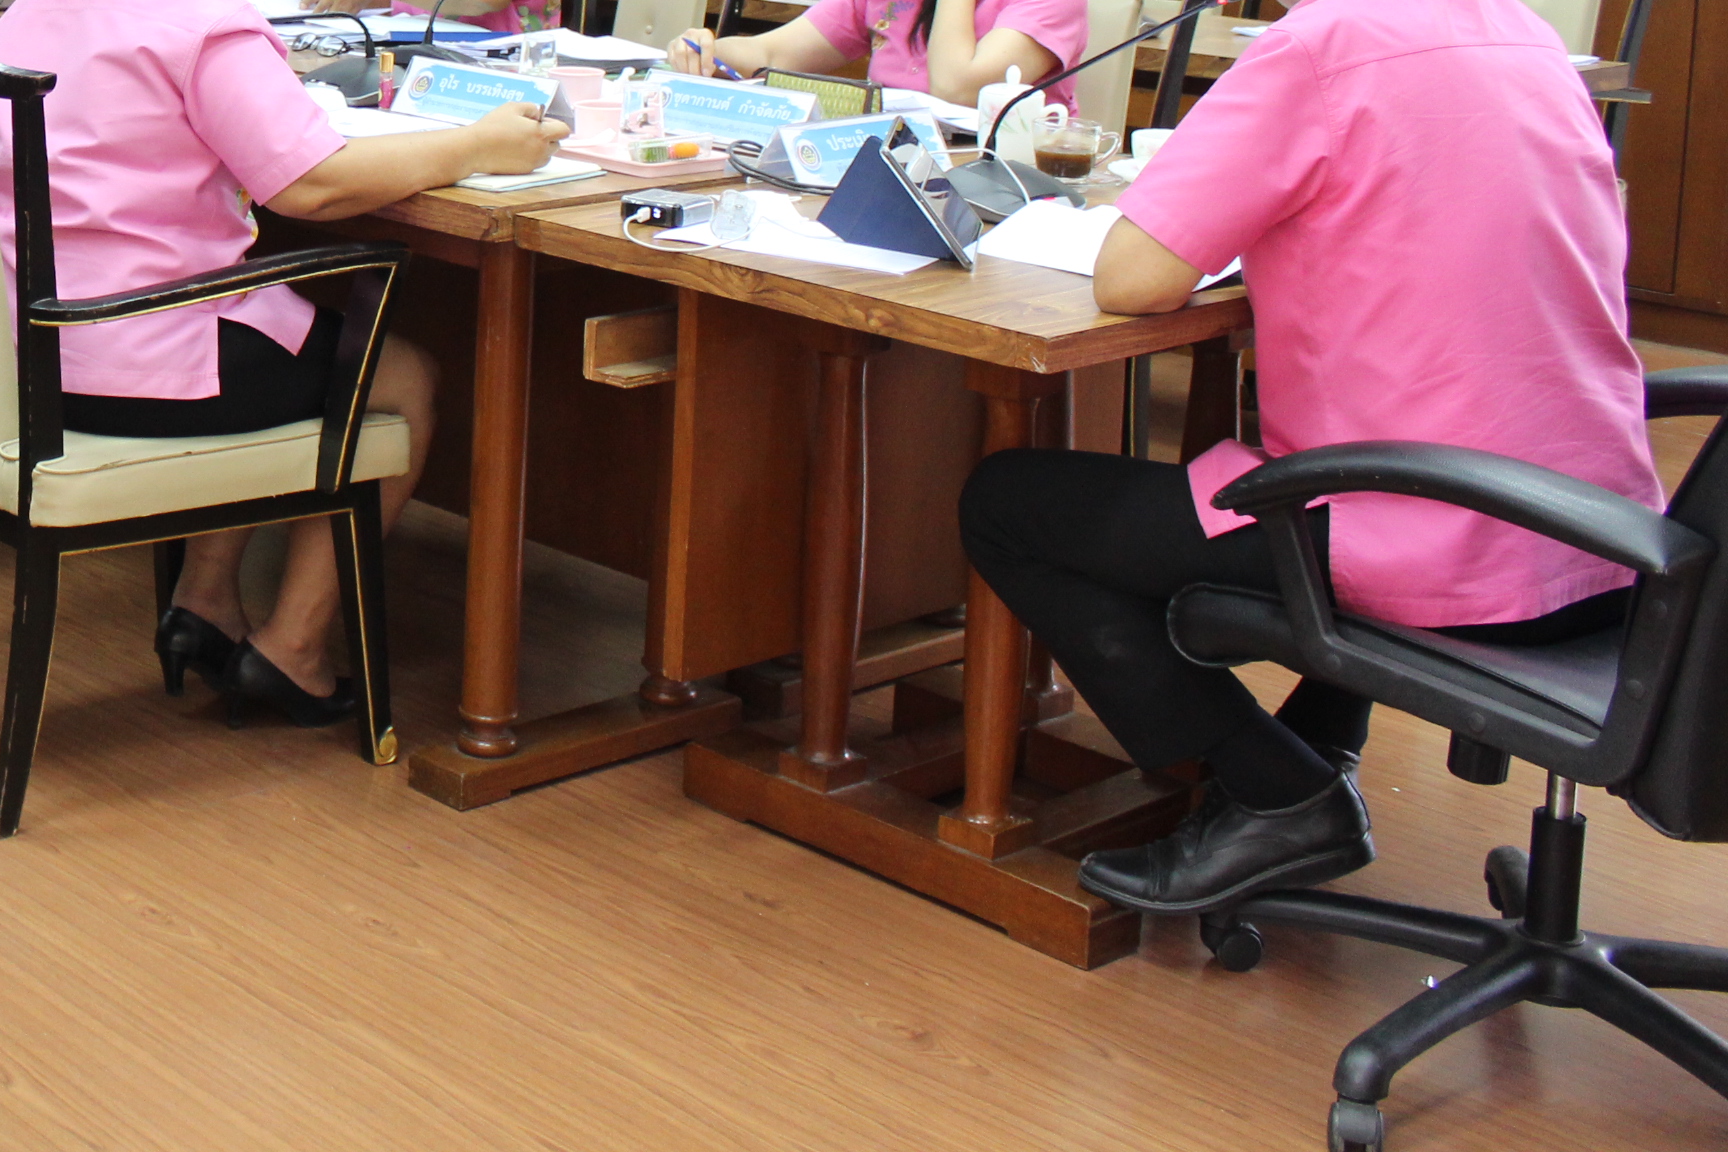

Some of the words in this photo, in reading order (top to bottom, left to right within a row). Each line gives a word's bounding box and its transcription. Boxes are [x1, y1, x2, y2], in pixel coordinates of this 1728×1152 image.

[438, 73, 460, 92] อุไร
[466, 82, 525, 101] บรรเทิงสุข
[738, 99, 791, 120] กำจัดภัย
[826, 129, 872, 151] ประเมิ
